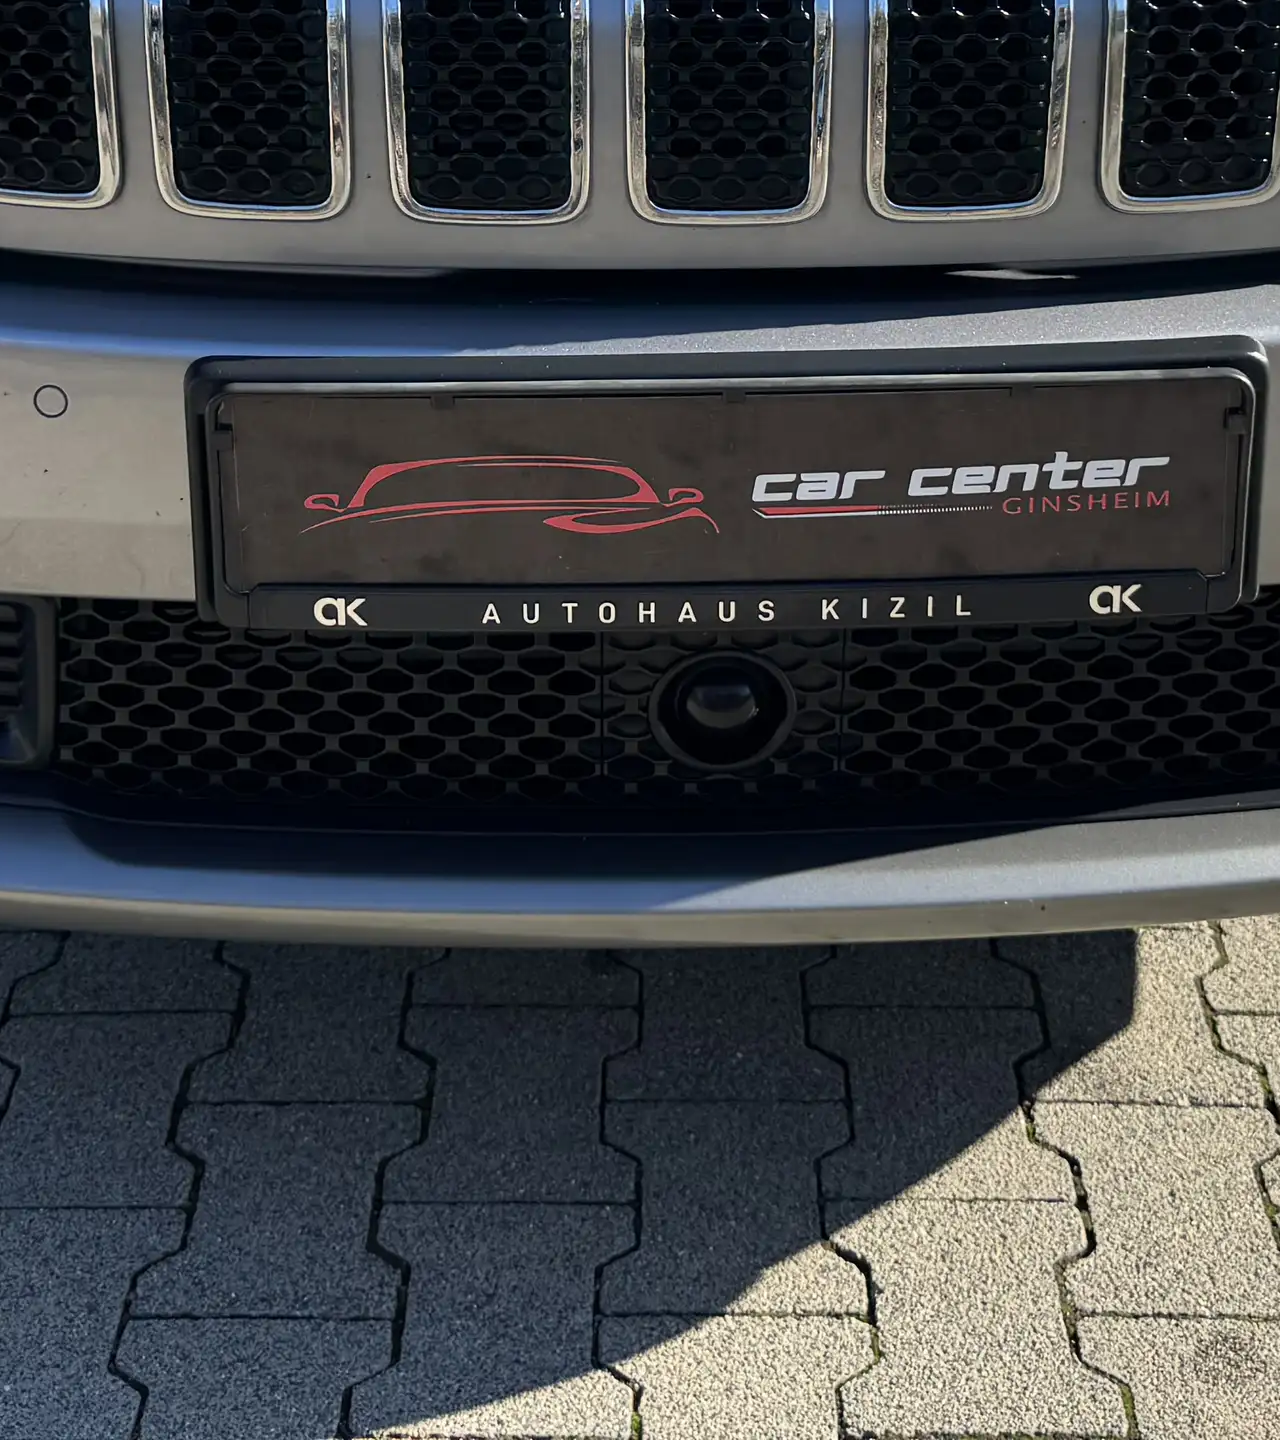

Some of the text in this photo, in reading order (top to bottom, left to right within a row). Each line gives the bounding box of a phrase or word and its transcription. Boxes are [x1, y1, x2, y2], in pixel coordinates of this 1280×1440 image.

[751, 451, 1170, 502] car center
[1001, 490, 1171, 515] GINSHEIM
[481, 600, 775, 625] AUTOHAUS
[821, 594, 972, 621] KIZIL
